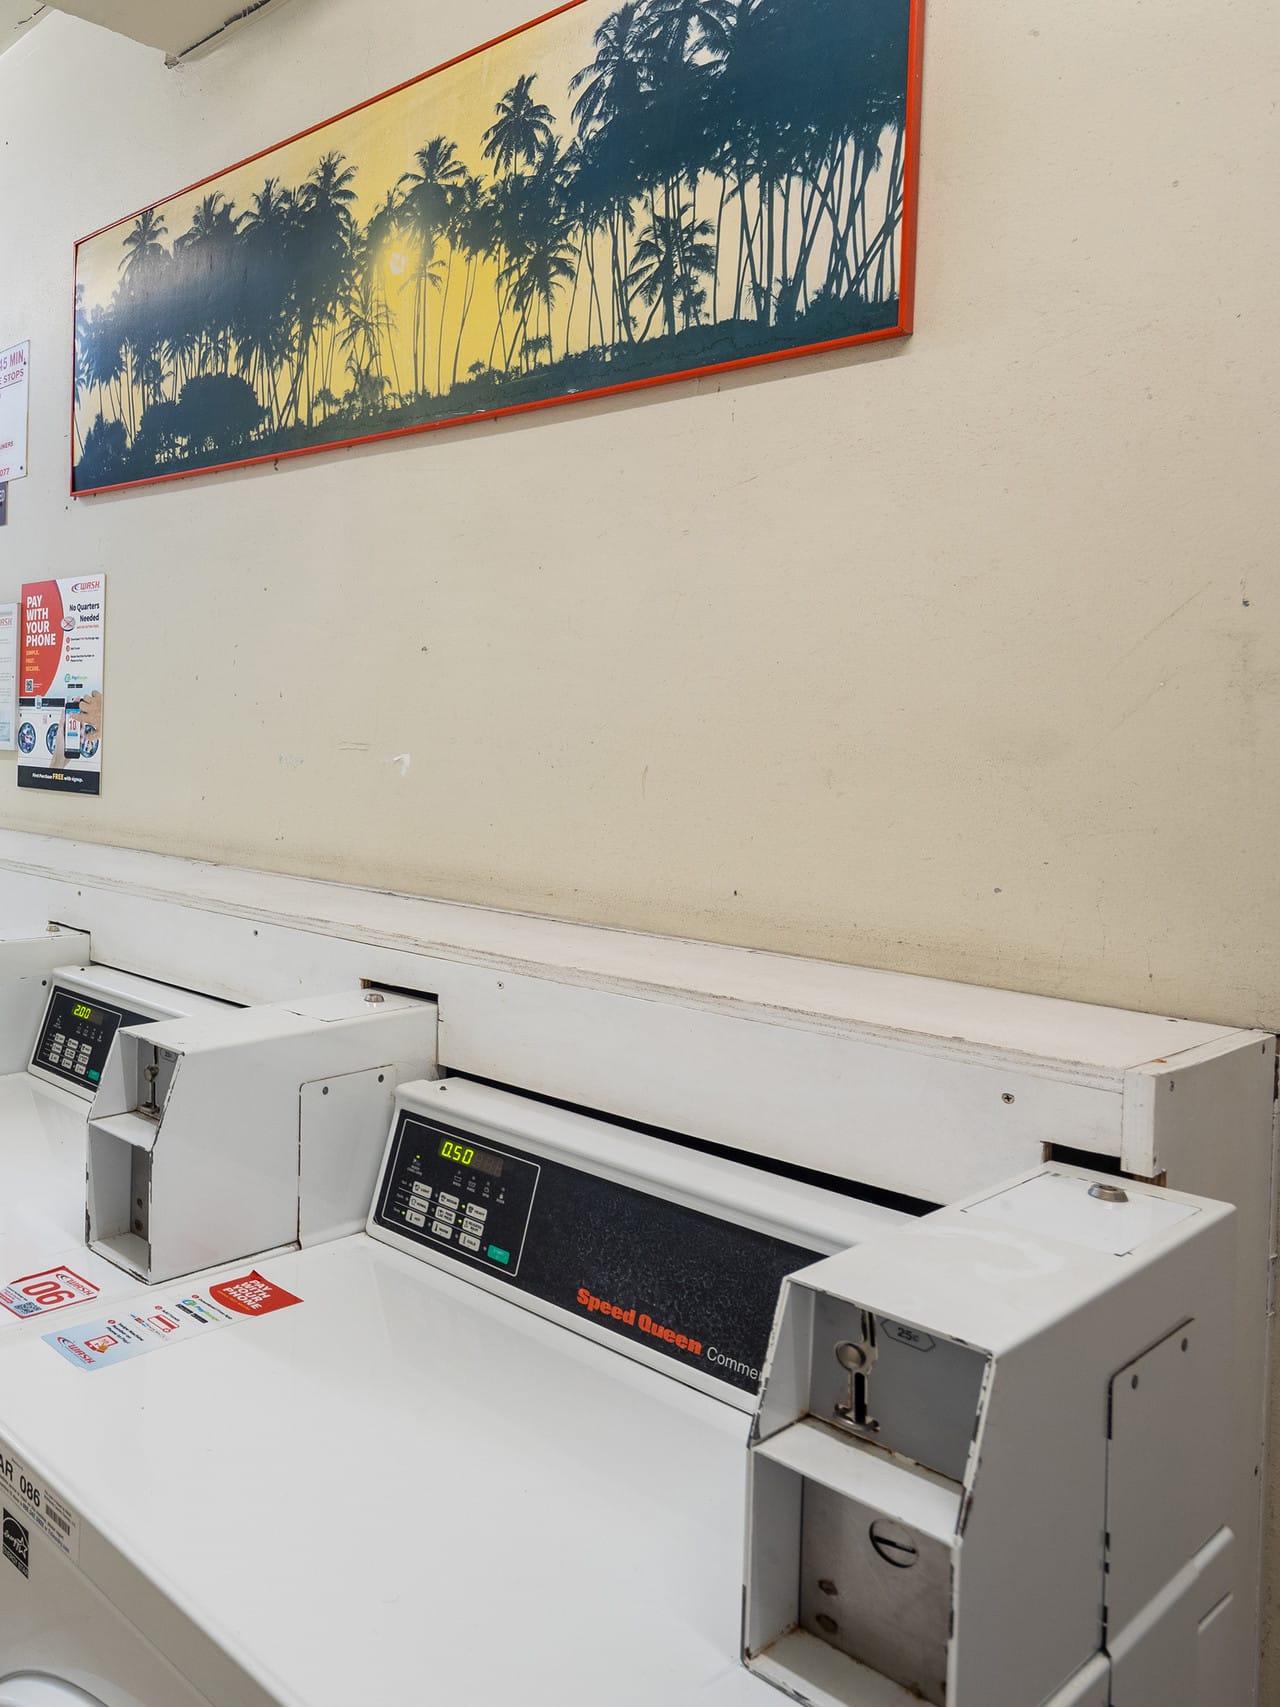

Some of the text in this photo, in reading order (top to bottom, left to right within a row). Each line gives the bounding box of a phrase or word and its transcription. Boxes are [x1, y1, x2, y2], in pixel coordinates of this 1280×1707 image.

[0, 357, 7, 371] 45
[10, 349, 25, 367] MIN.
[3, 369, 24, 383] STOPS
[80, 581, 100, 590] WASH
[26, 595, 42, 608] PAY
[69, 603, 100, 612] No Quarters
[26, 608, 48, 620] WITH
[80, 613, 99, 622] Needed
[26, 621, 49, 634] YOUR
[26, 633, 56, 647] PHONE
[69, 720, 77, 731] 10
[441, 1141, 474, 1165] 0.50
[66, 1279, 94, 1296] WASH
[241, 1282, 271, 1299] WITH
[249, 1279, 272, 1291] PAY
[22, 1281, 75, 1305] 06
[223, 1287, 262, 1310] PHONE
[233, 1285, 263, 1303] YOUR
[577, 1288, 636, 1326] Speed
[638, 1314, 702, 1355] Queen
[68, 1343, 96, 1365] WASH
[20, 1475, 41, 1507] 086
